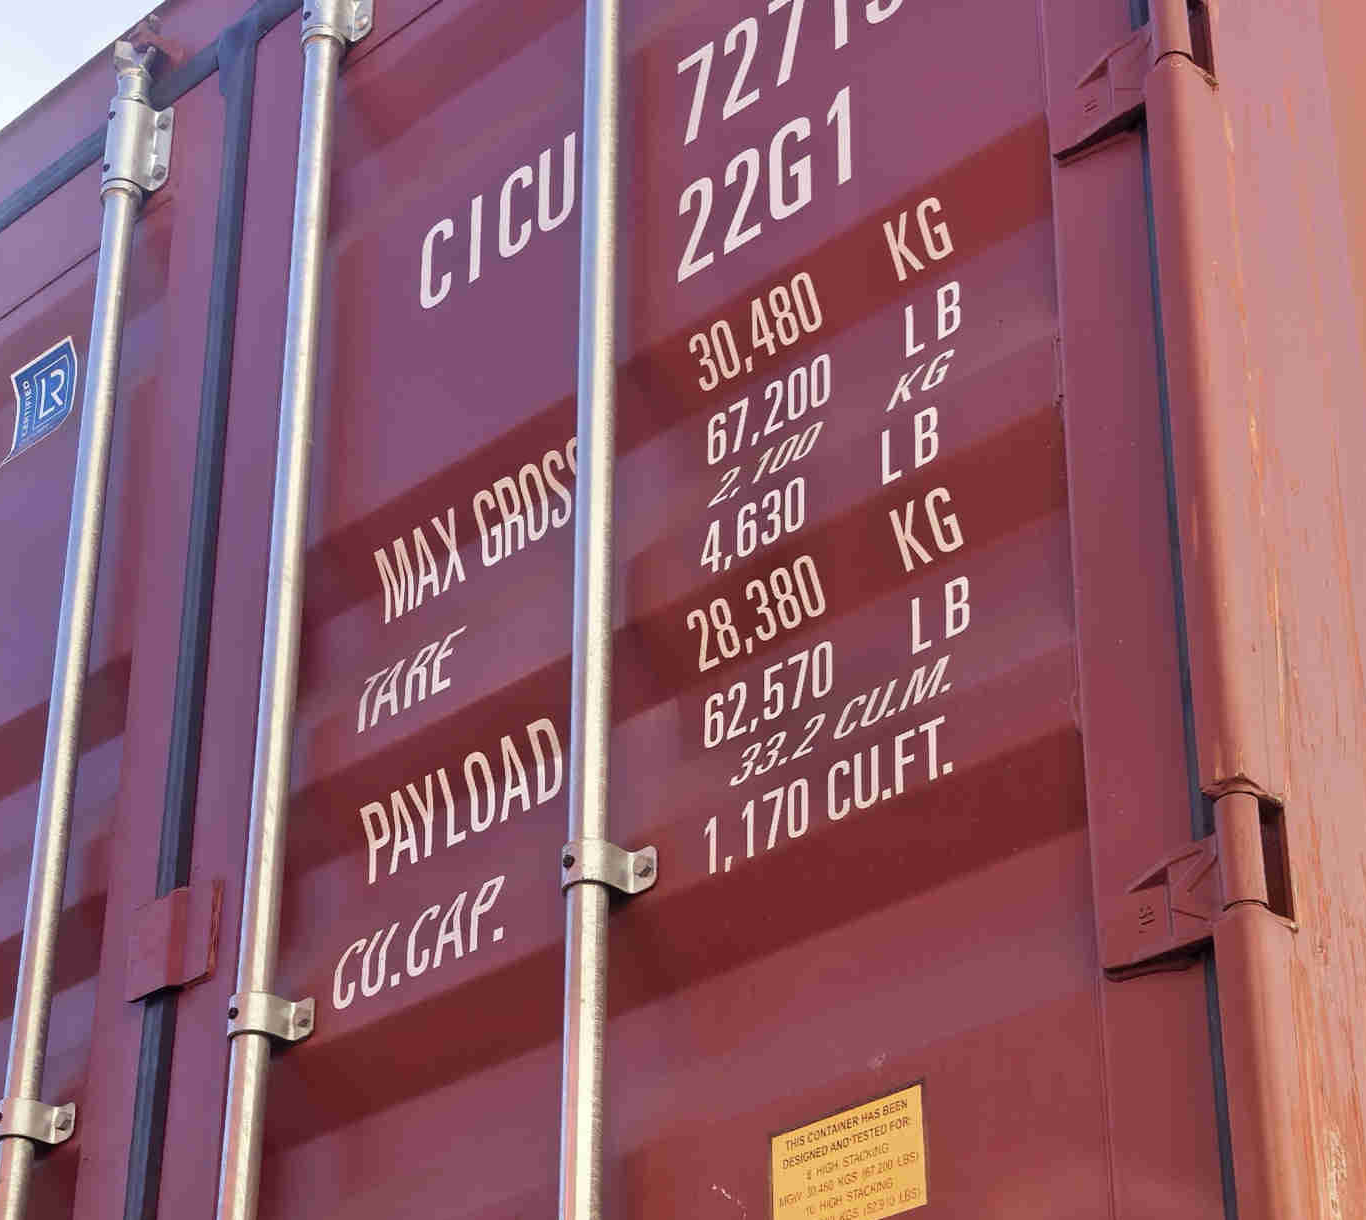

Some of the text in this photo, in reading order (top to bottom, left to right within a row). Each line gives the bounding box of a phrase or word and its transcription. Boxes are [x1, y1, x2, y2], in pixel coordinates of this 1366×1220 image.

[420, 131, 577, 310] CICU
[677, 85, 852, 283] 22G1
[689, 196, 955, 393] 30,480 KG
[707, 280, 962, 466] 67,200 LB
[701, 406, 939, 573] 4,630 LB
[707, 349, 955, 508] 2,100 KG
[373, 508, 466, 624] MAX
[687, 487, 964, 672] 28,380 KG
[356, 627, 466, 733] TARE
[703, 576, 971, 748] 62,570 LB
[729, 656, 953, 785] 33.2 CU.M.
[359, 717, 563, 884] PAYLOAD
[703, 716, 955, 875] 1,170 CU.FT.
[333, 875, 506, 1010] CU.CAP.
[782, 1146, 829, 1170] DESIGNED
[851, 1124, 888, 1145] TESTED
[785, 1098, 909, 1152] THIS CONTAINER HAS BEEN
[816, 1159, 839, 1176] HIGH
[842, 1142, 890, 1168] STACKING
[819, 1195, 843, 1213] HIGH
[846, 1176, 894, 1202] STACKING
